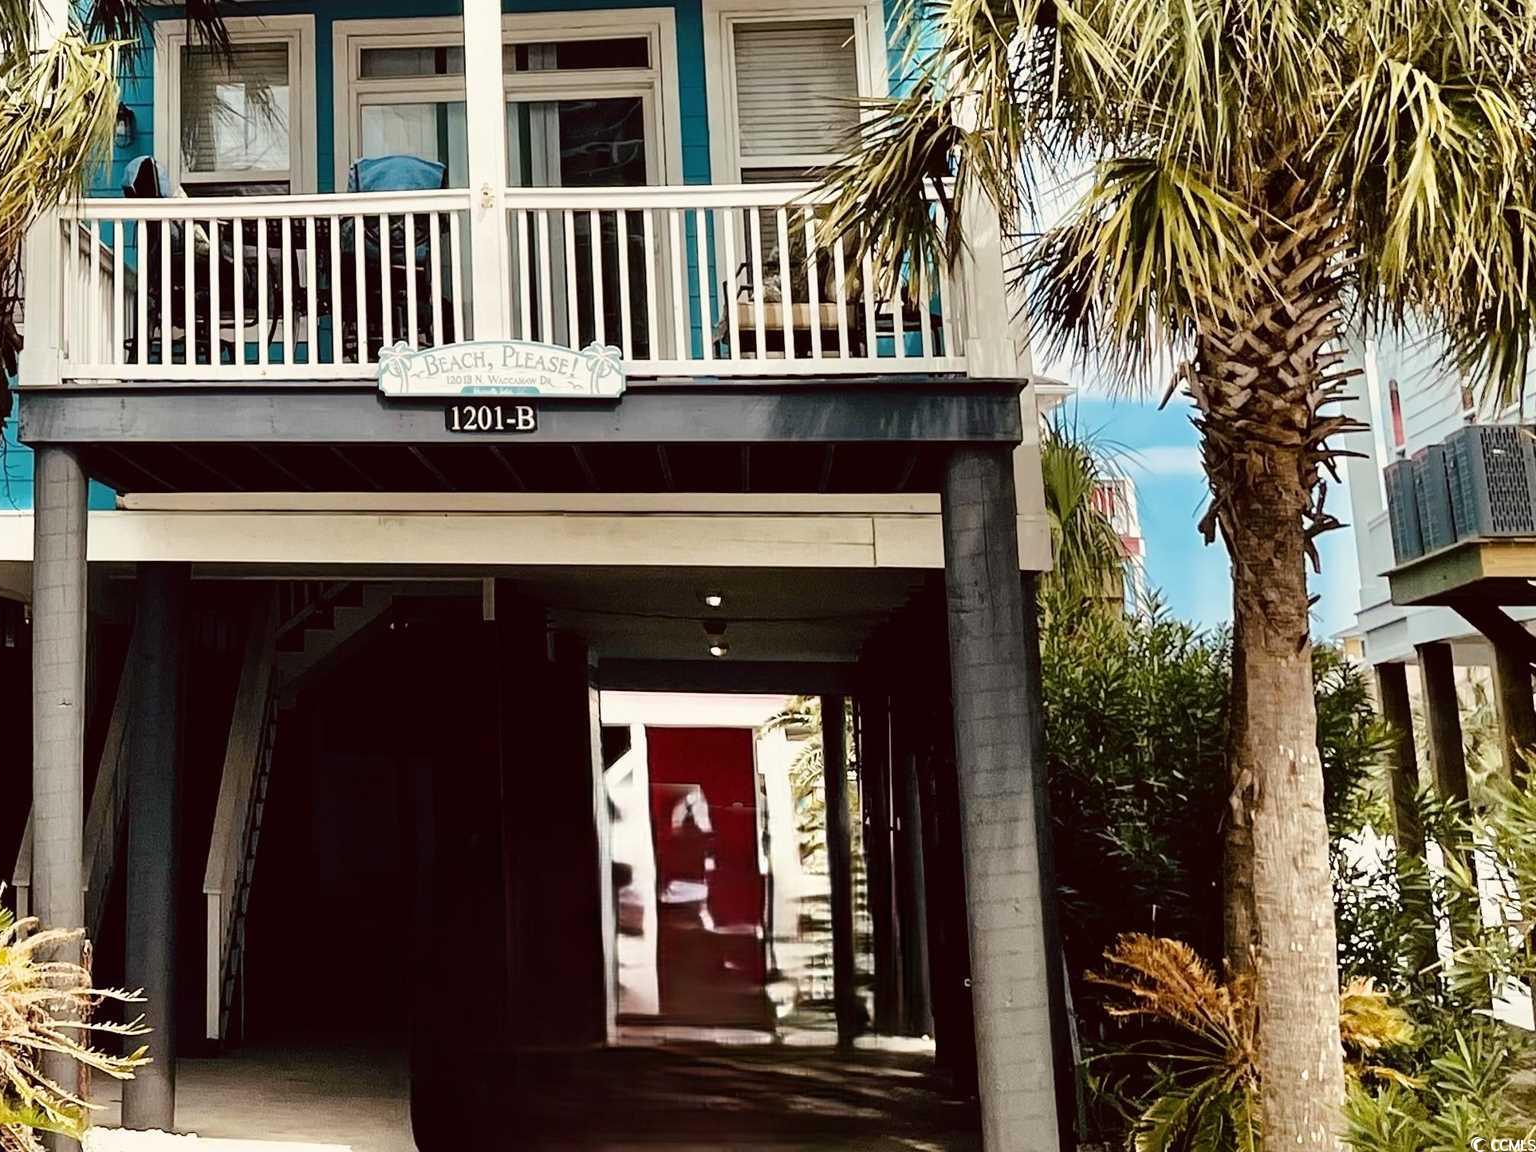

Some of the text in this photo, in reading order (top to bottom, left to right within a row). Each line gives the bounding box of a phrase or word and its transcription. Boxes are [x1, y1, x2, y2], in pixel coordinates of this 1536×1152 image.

[424, 345, 578, 377] BEACH, PLEASE!
[451, 405, 535, 430] 1201-B
